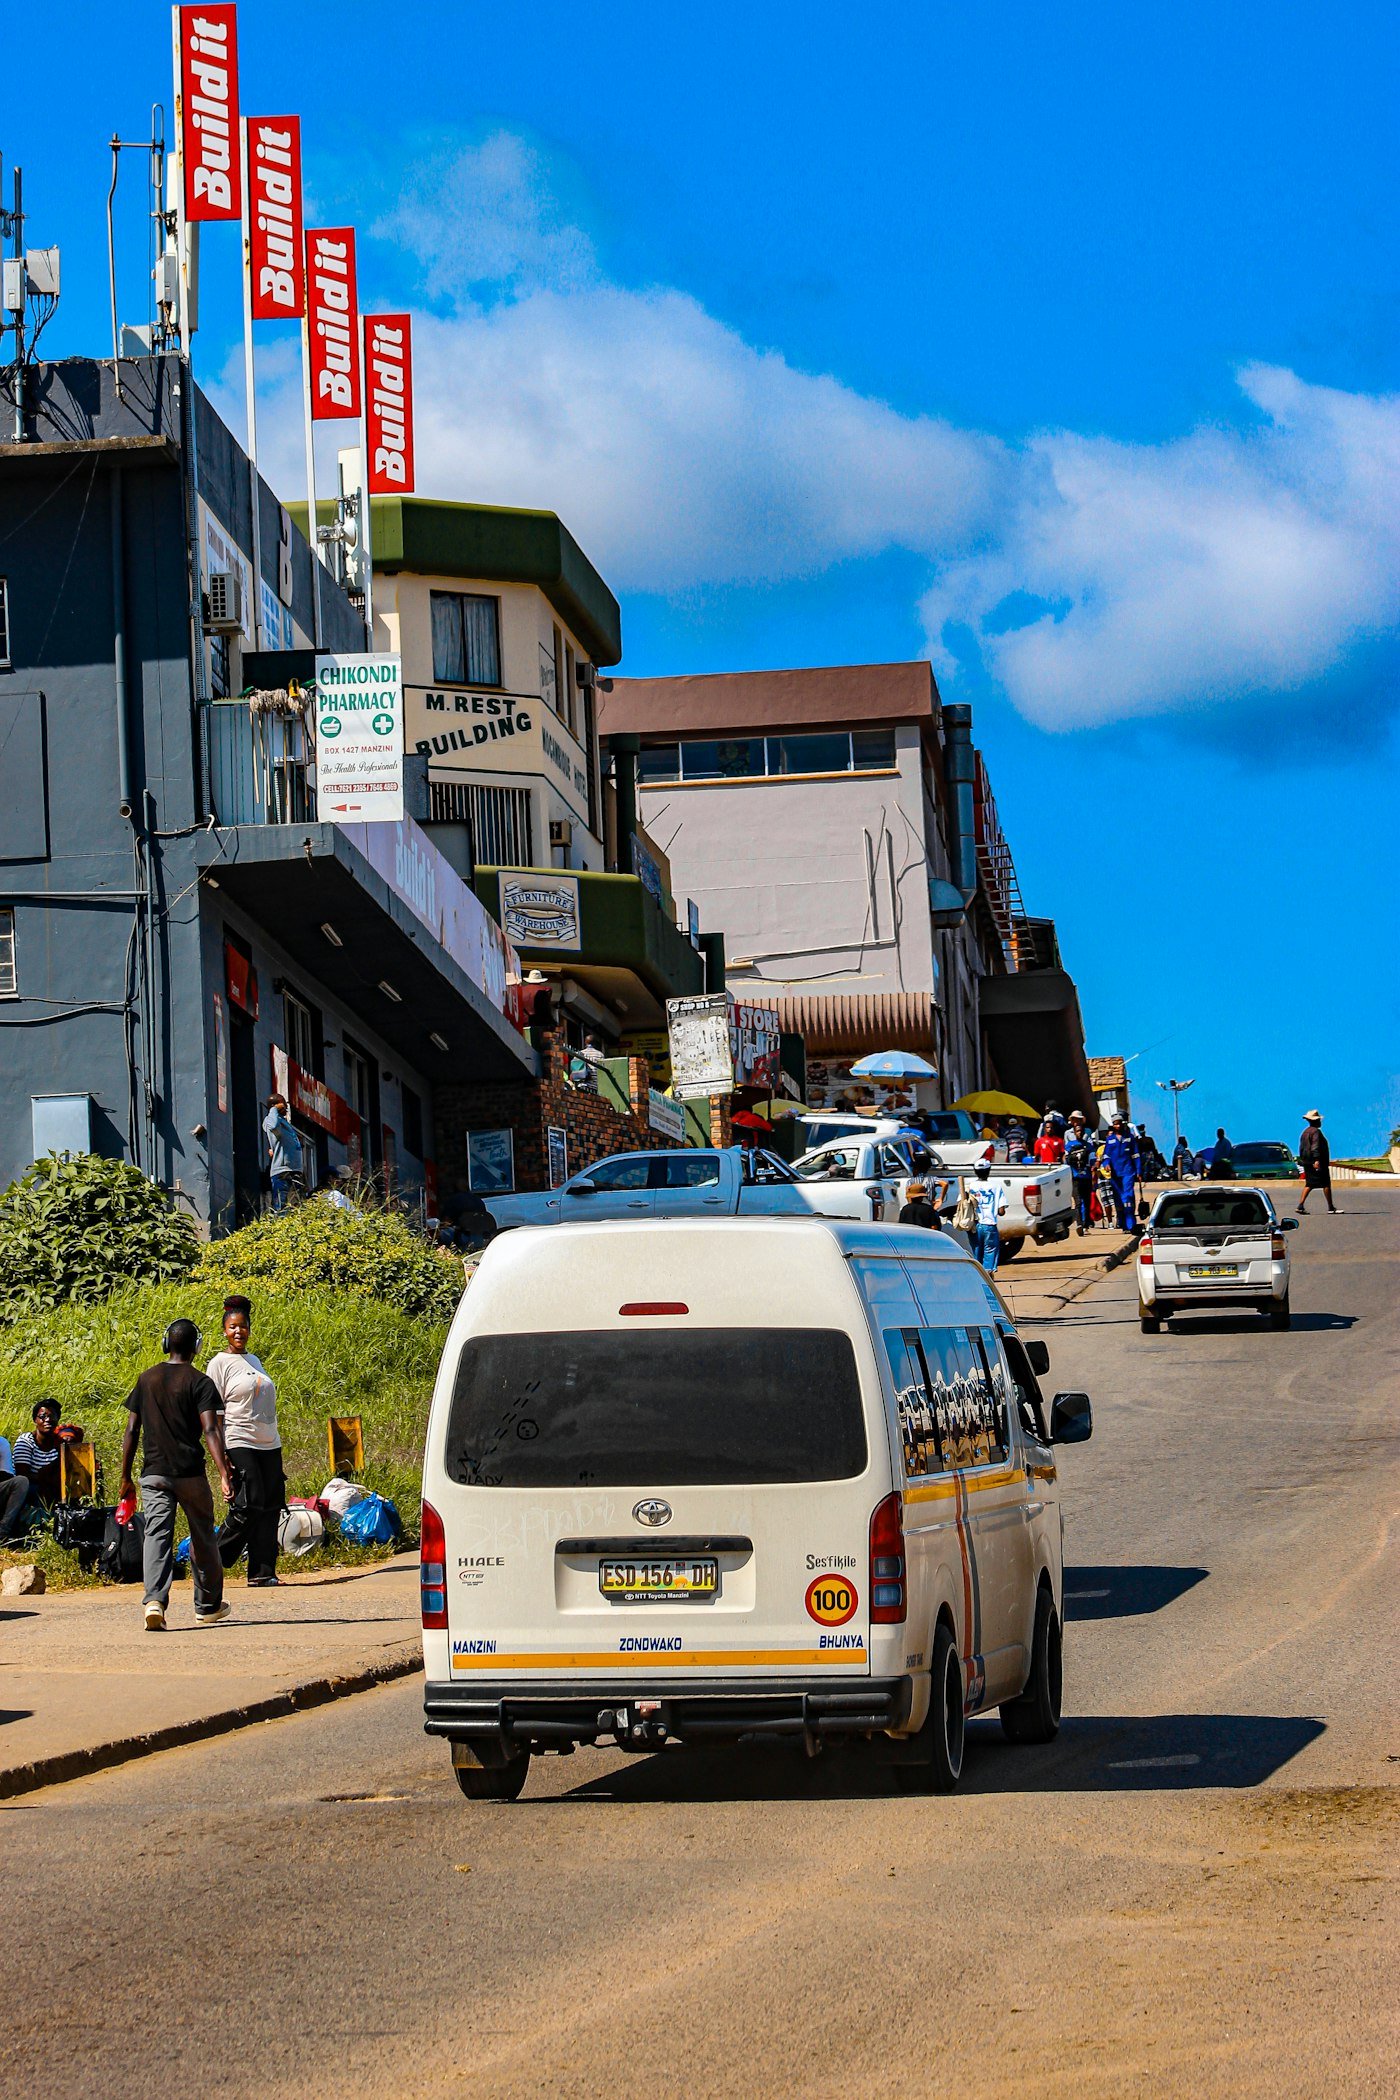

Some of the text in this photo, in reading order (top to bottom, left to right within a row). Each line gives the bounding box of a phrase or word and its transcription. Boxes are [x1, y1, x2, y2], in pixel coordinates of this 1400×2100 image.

[190, 17, 231, 210] Build it
[256, 126, 295, 307] Build it
[315, 237, 352, 407] Build it
[373, 323, 406, 483] Build it
[320, 665, 396, 685] CHIKONDI
[319, 691, 396, 711] PHARMACY
[415, 712, 532, 759] BUILDING
[324, 745, 393, 755] BOX 1427 MANZINI
[320, 760, 398, 775] The Health Professionals
[511, 892, 569, 909] FURNITURE
[514, 914, 569, 930] WAREHOUSE
[740, 1006, 779, 1033] STORE
[458, 1557, 505, 1567] HIACE
[603, 1563, 715, 1587] ESD 156 DH
[813, 1589, 850, 1611] 100
[453, 1640, 498, 1654] MANZINI
[619, 1637, 683, 1652] ZONDWAKO
[819, 1634, 864, 1649] BHUNYA
